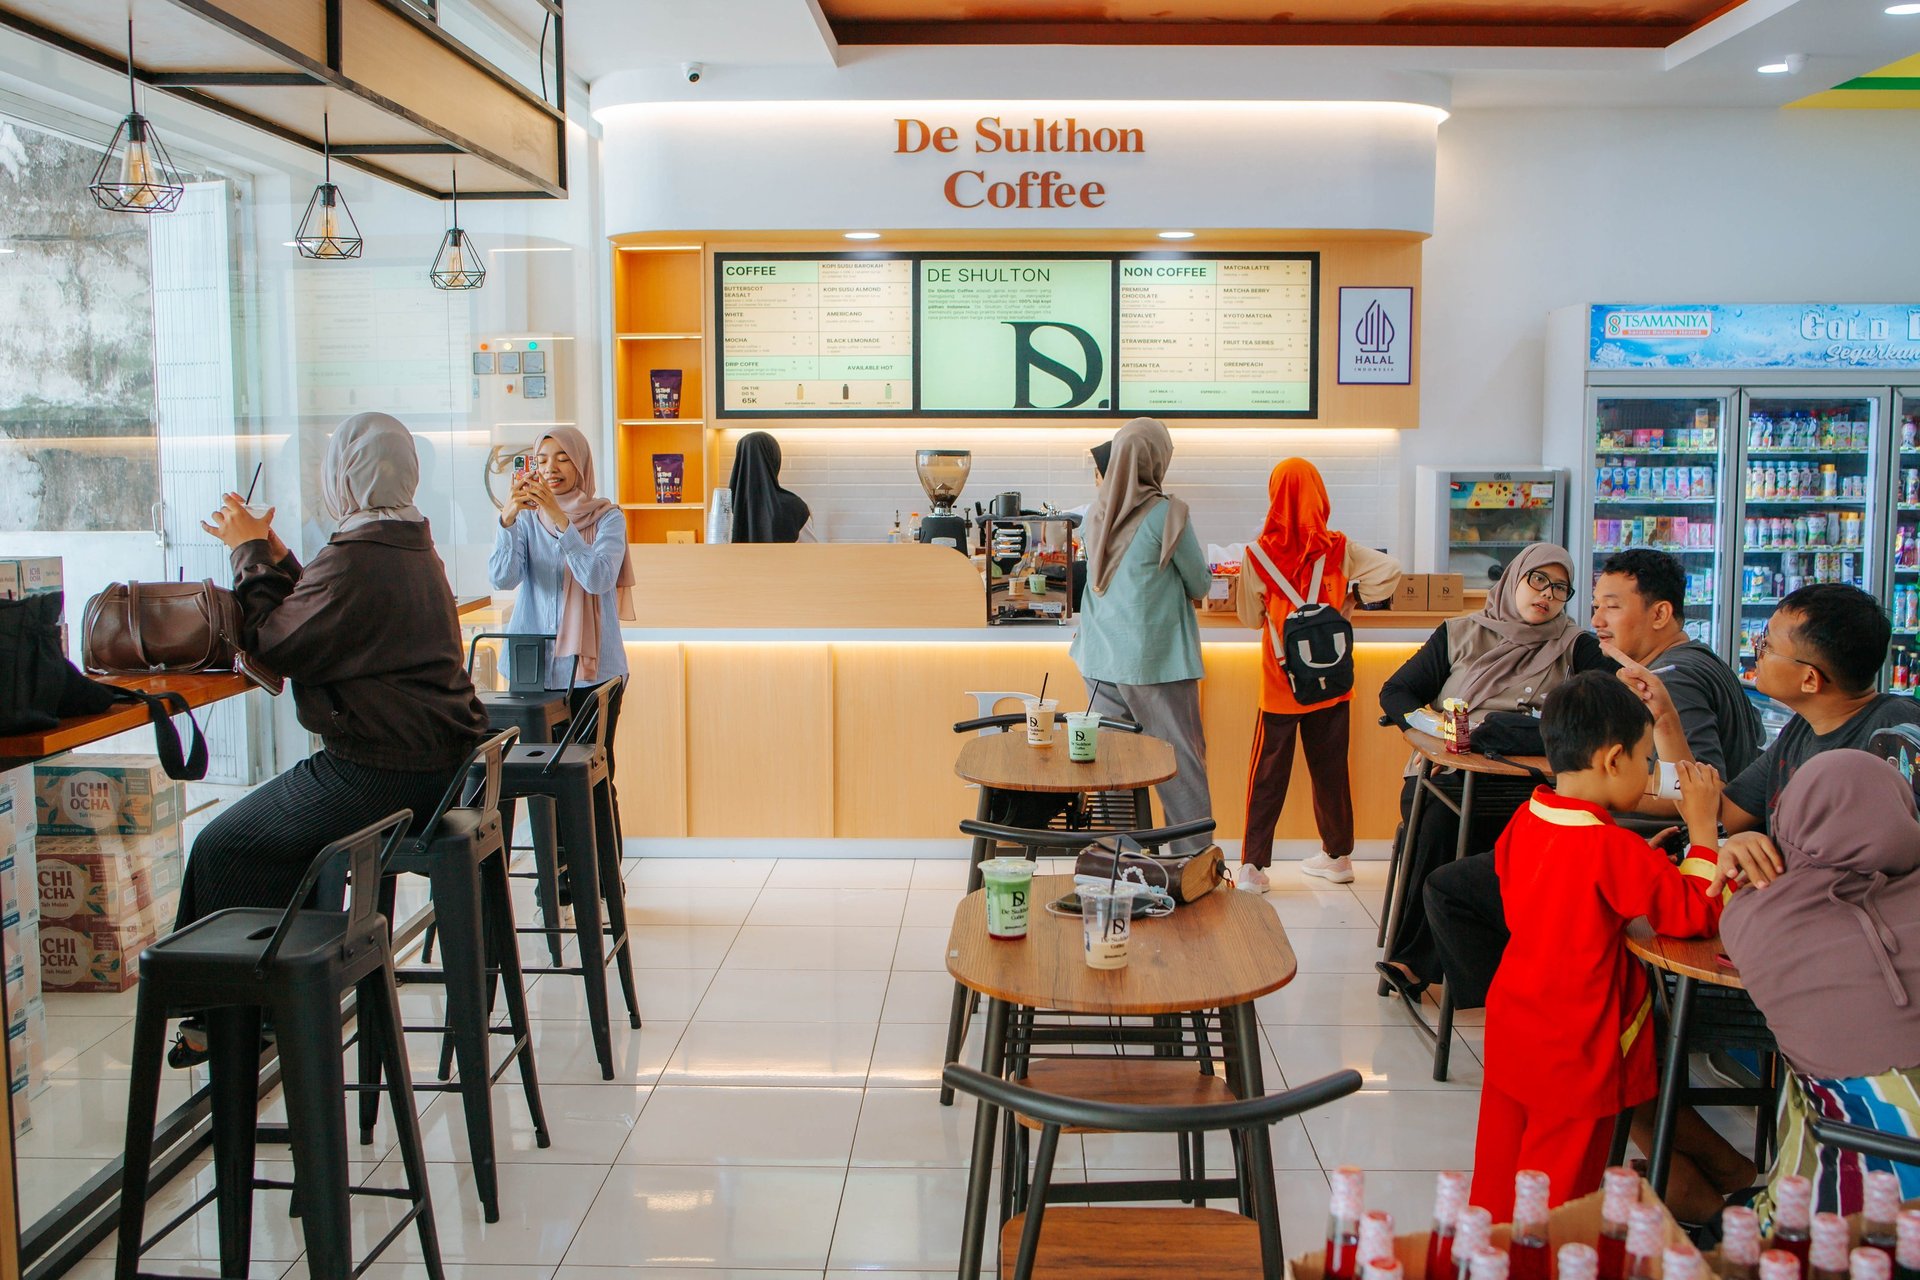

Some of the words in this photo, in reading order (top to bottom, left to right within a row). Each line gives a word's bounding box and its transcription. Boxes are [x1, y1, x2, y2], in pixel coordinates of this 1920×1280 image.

[894, 118, 958, 154] De
[975, 116, 1146, 154] Sulthon
[944, 170, 1106, 209] Coffee
[726, 266, 776, 276] COFFEE
[928, 268, 951, 282] DE
[958, 268, 1050, 282] SHULTON
[1124, 267, 1153, 277] NON
[1156, 267, 1207, 277] COFFEE
[1622, 314, 1708, 327] TSAMANIYA
[1355, 355, 1394, 364] HALAL
[70, 782, 109, 798] ICHI
[70, 799, 110, 810] OCHA
[38, 871, 72, 887] CHI
